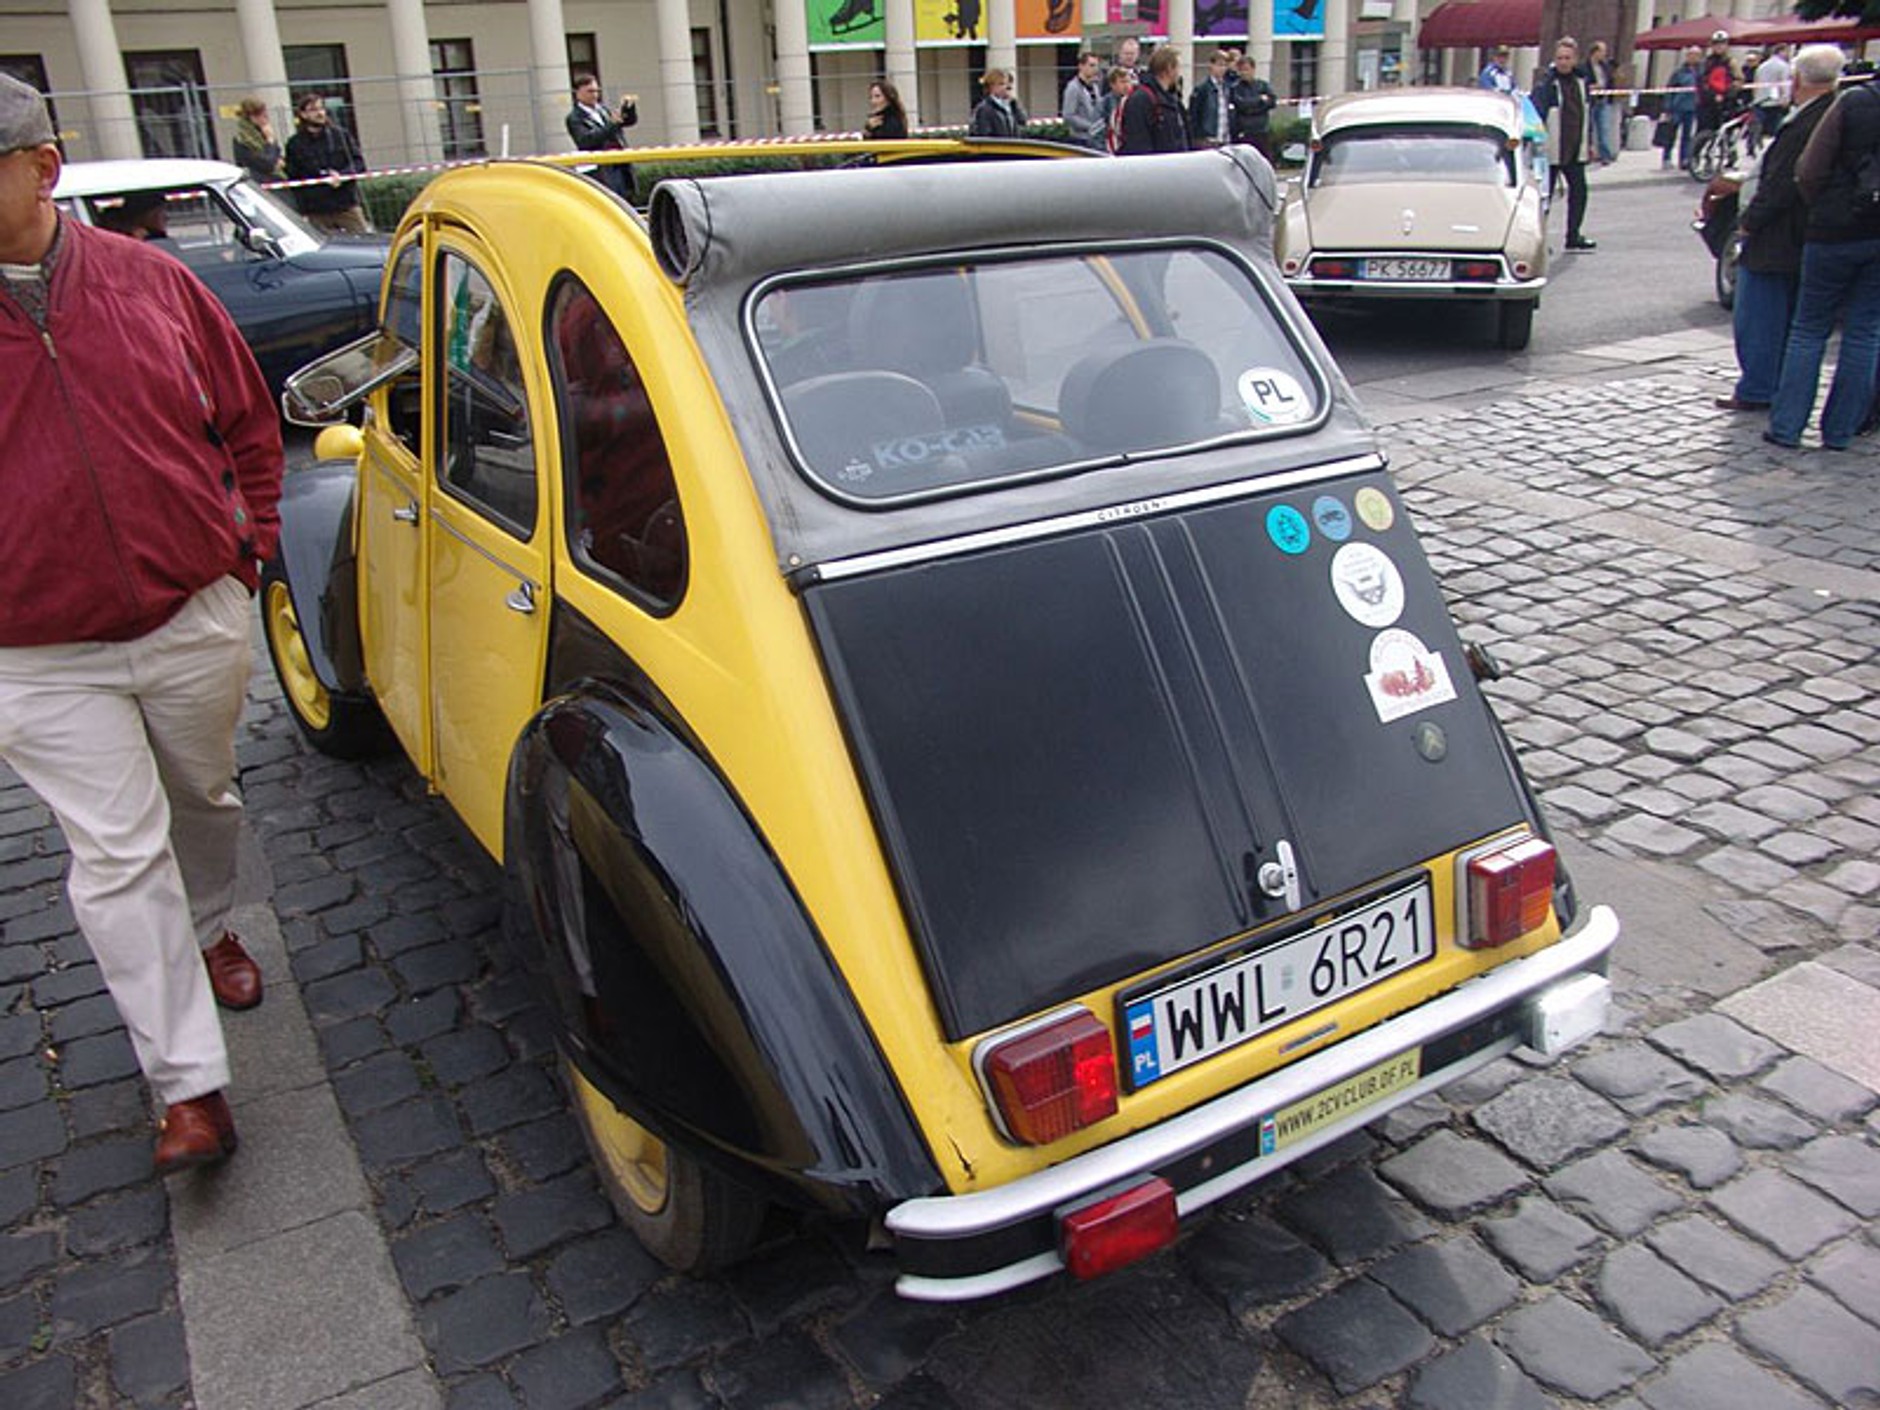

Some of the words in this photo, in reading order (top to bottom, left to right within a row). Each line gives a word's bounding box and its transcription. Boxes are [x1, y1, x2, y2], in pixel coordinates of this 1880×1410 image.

[1367, 260, 1391, 277] PK
[1251, 379, 1294, 405] PL
[1166, 963, 1287, 1061] WWL
[1310, 898, 1420, 998] 6R21
[1134, 1054, 1156, 1073] PL
